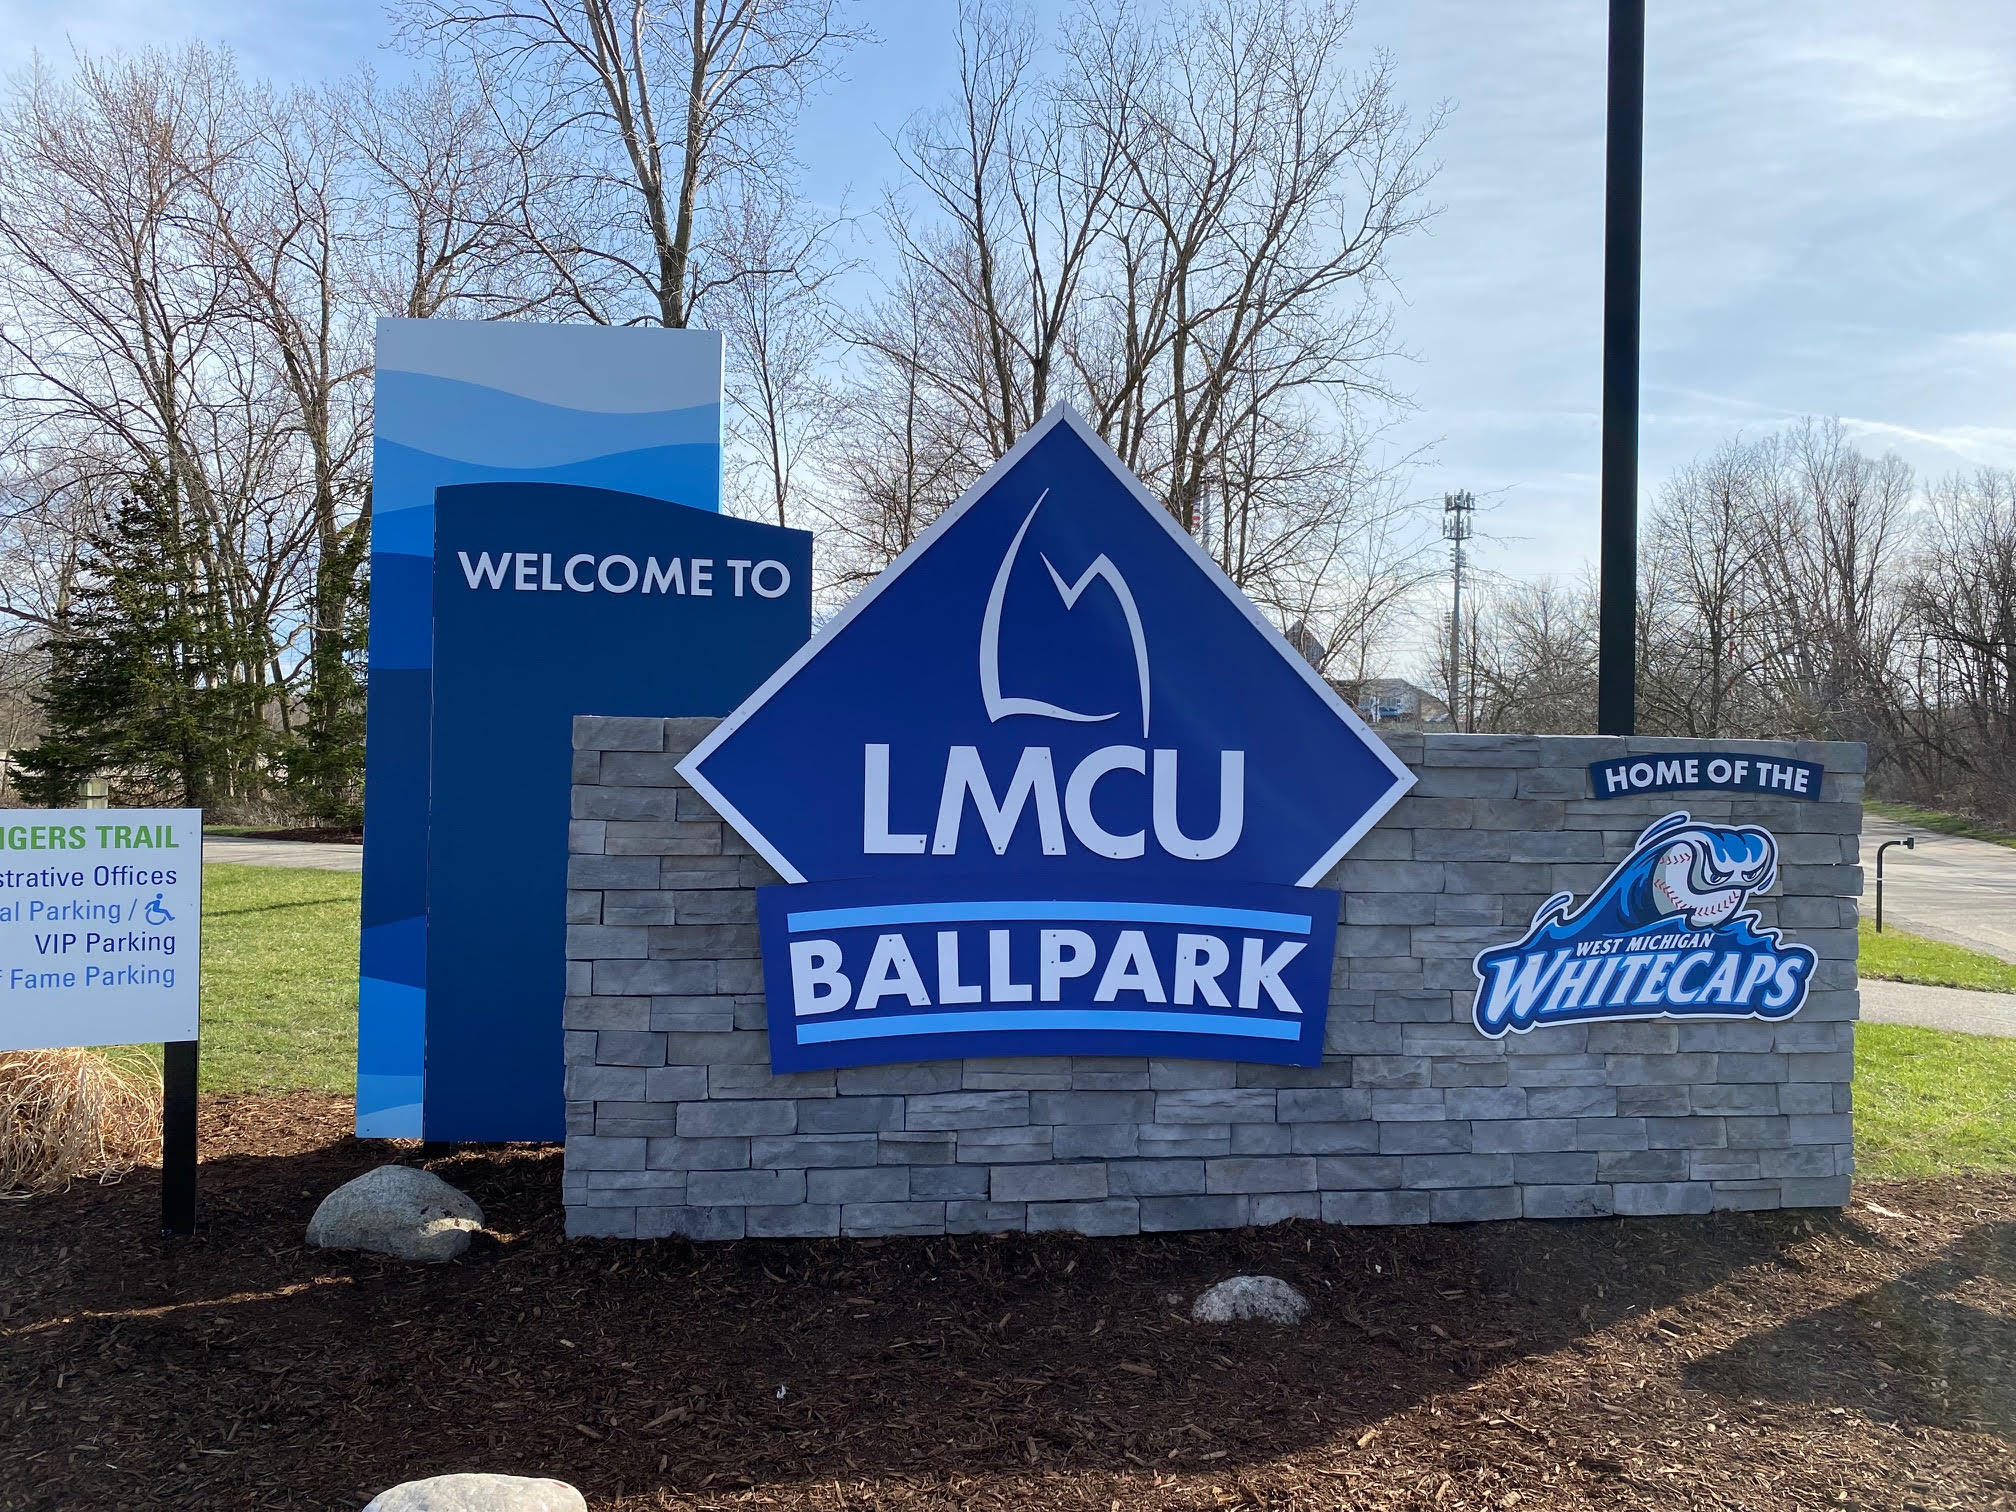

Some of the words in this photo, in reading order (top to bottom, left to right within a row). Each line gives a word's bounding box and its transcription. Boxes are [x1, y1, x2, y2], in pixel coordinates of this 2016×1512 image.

[457, 551, 713, 597] WELCOME
[727, 559, 791, 599] TO
[1605, 759, 1699, 792] HOME
[1706, 758, 1749, 784] OF
[1756, 762, 1810, 793] THE
[863, 743, 1245, 861] LMCU
[96, 825, 180, 849] TRAIL
[94, 865, 177, 887] Offices
[29, 899, 121, 924] Parking
[35, 933, 76, 955] VIP
[86, 931, 176, 955] Parking
[1576, 938, 1624, 957] WEST
[1626, 932, 1715, 952] MICHIGAN
[10, 968, 76, 990] Fame
[86, 964, 175, 989] Parking
[788, 929, 1308, 1016] BALLPARK
[1484, 948, 1806, 1024] WHITECAPS
